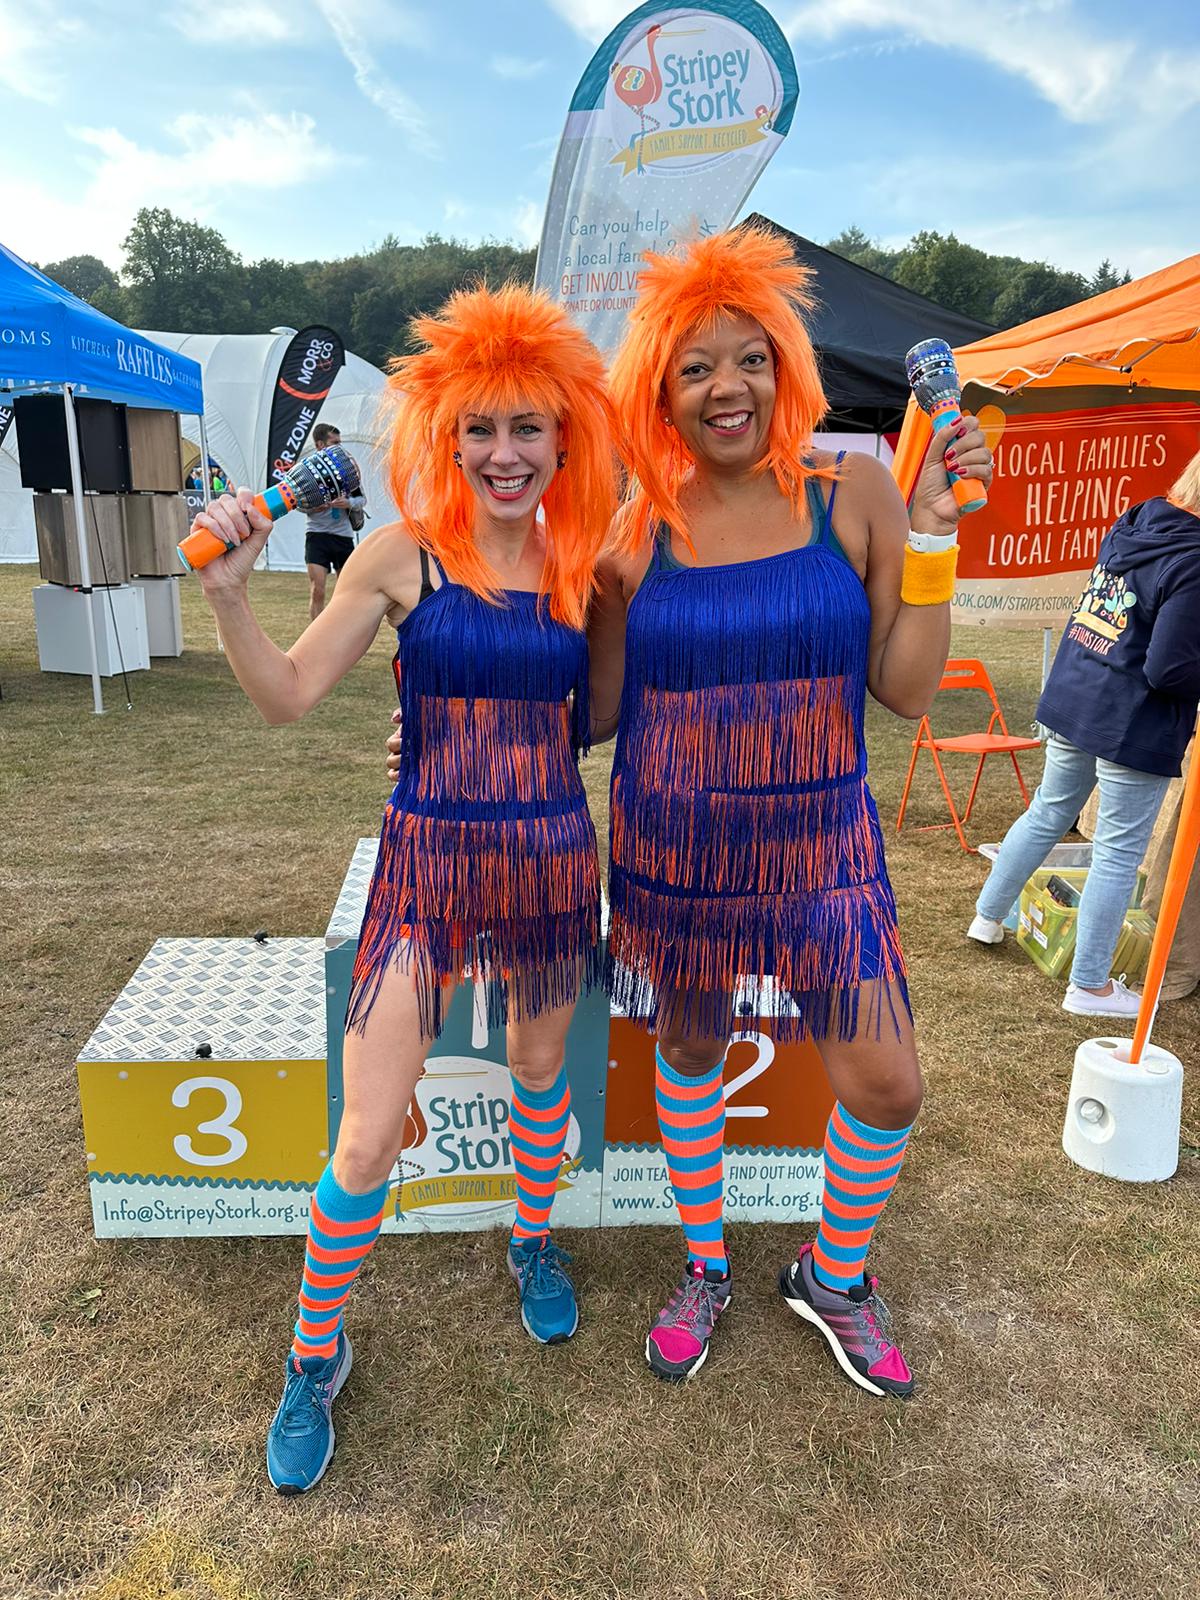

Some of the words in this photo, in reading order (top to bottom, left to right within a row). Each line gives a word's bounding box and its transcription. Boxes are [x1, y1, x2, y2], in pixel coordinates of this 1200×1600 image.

[663, 48, 750, 89] Stripey
[668, 79, 744, 127] Stork
[569, 215, 597, 236] Can
[603, 222, 629, 239] you
[635, 209, 669, 236] help
[564, 256, 572, 267] a
[577, 242, 612, 266] local
[561, 273, 583, 295] GET
[590, 299, 601, 312] OR
[71, 335, 111, 359] KITCHENS
[116, 338, 173, 386] RAFFLES
[297, 338, 325, 384] MORR
[320, 342, 334, 359] CO
[286, 406, 316, 451] ZONE
[998, 440, 1066, 477] LOCAL
[1076, 434, 1167, 473] FAMILIES
[1026, 475, 1132, 526] HELPING
[988, 532, 1051, 566] LOCAL
[722, 1030, 776, 1118] 2
[172, 1076, 248, 1167] 3
[429, 1092, 510, 1134] Strip
[436, 1133, 512, 1174] Stor
[613, 1167, 643, 1182] JOIN
[646, 1167, 672, 1182] TEA
[729, 1166, 757, 1180] FIND
[761, 1165, 785, 1180] OUT
[103, 1196, 312, 1225] Info@StripeyStork.org.u
[411, 1181, 447, 1202] FAMILY
[500, 1179, 518, 1196] REC
